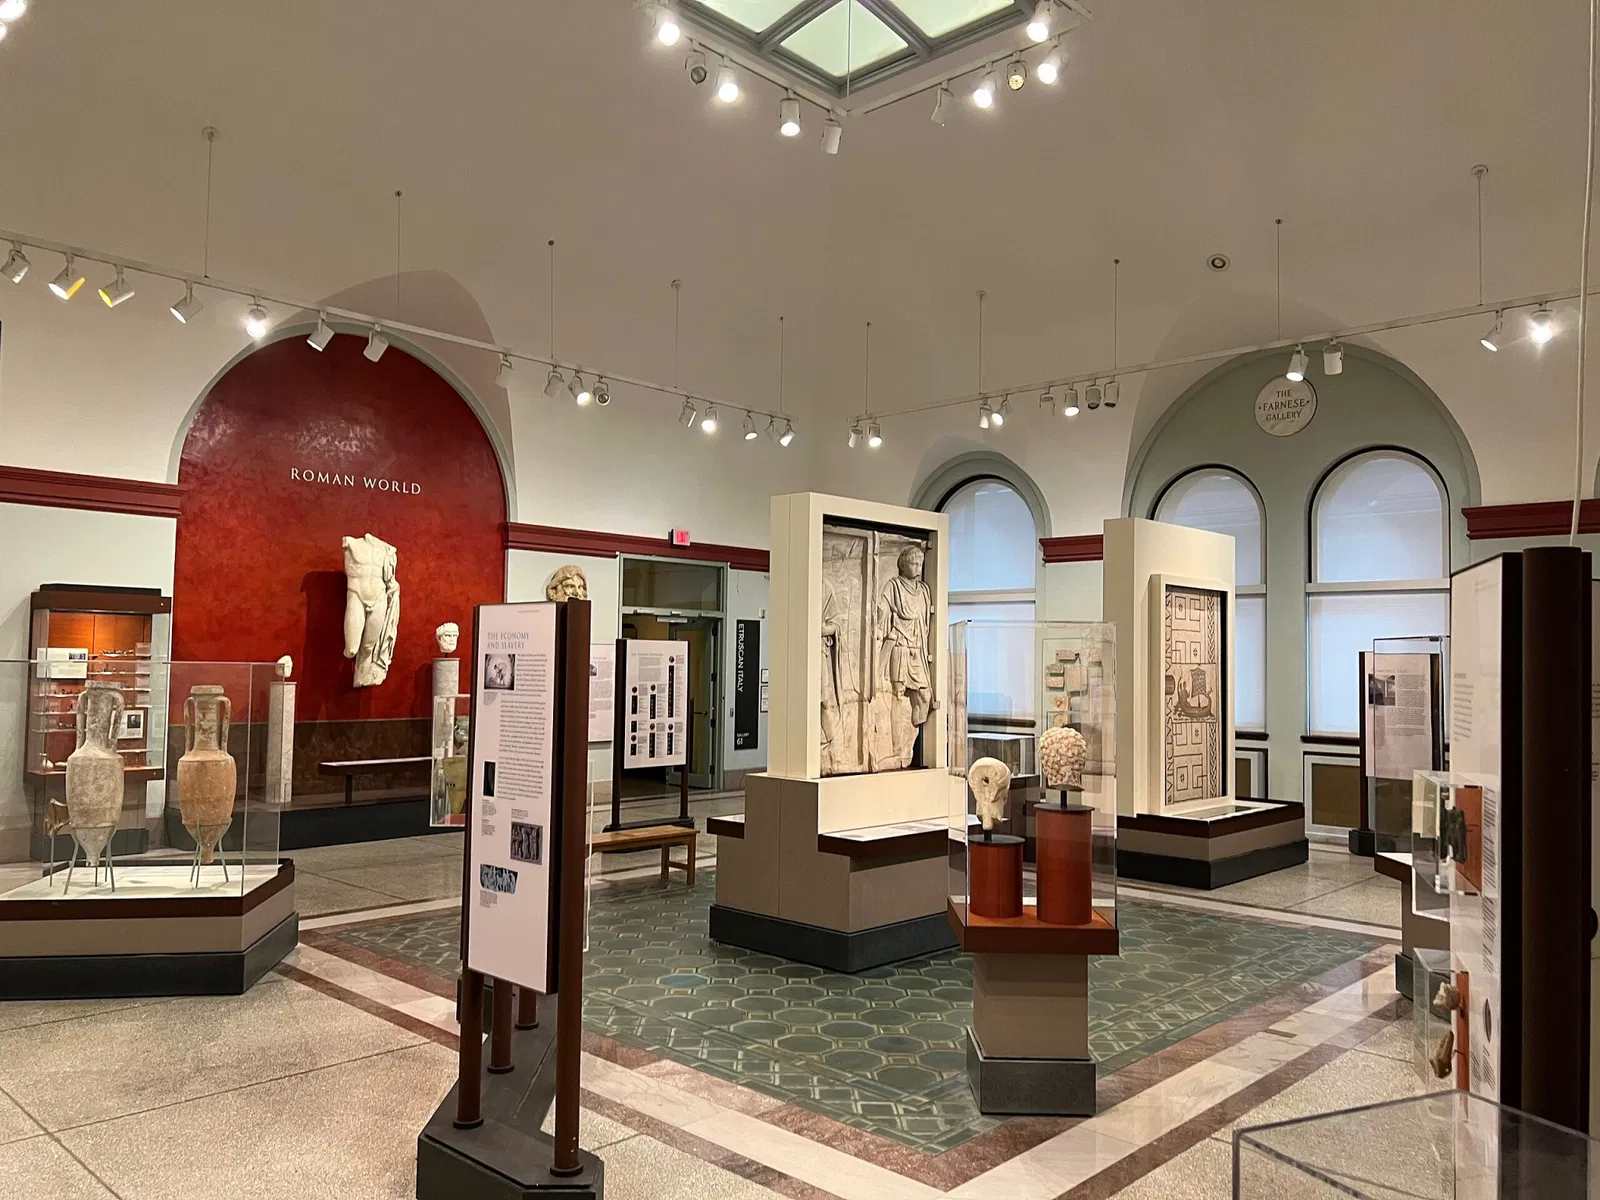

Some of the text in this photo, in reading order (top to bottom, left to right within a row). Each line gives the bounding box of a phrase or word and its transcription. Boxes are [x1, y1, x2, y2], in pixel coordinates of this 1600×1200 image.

[1276, 389, 1292, 398] THE
[1263, 398, 1305, 411] FARNESE
[1266, 408, 1303, 421] GALLERY
[291, 467, 421, 495] ROMAN WORLD
[488, 632, 529, 640] THE ECONOMY
[487, 641, 525, 649] AND SLAVERY
[736, 737, 744, 746] 61
